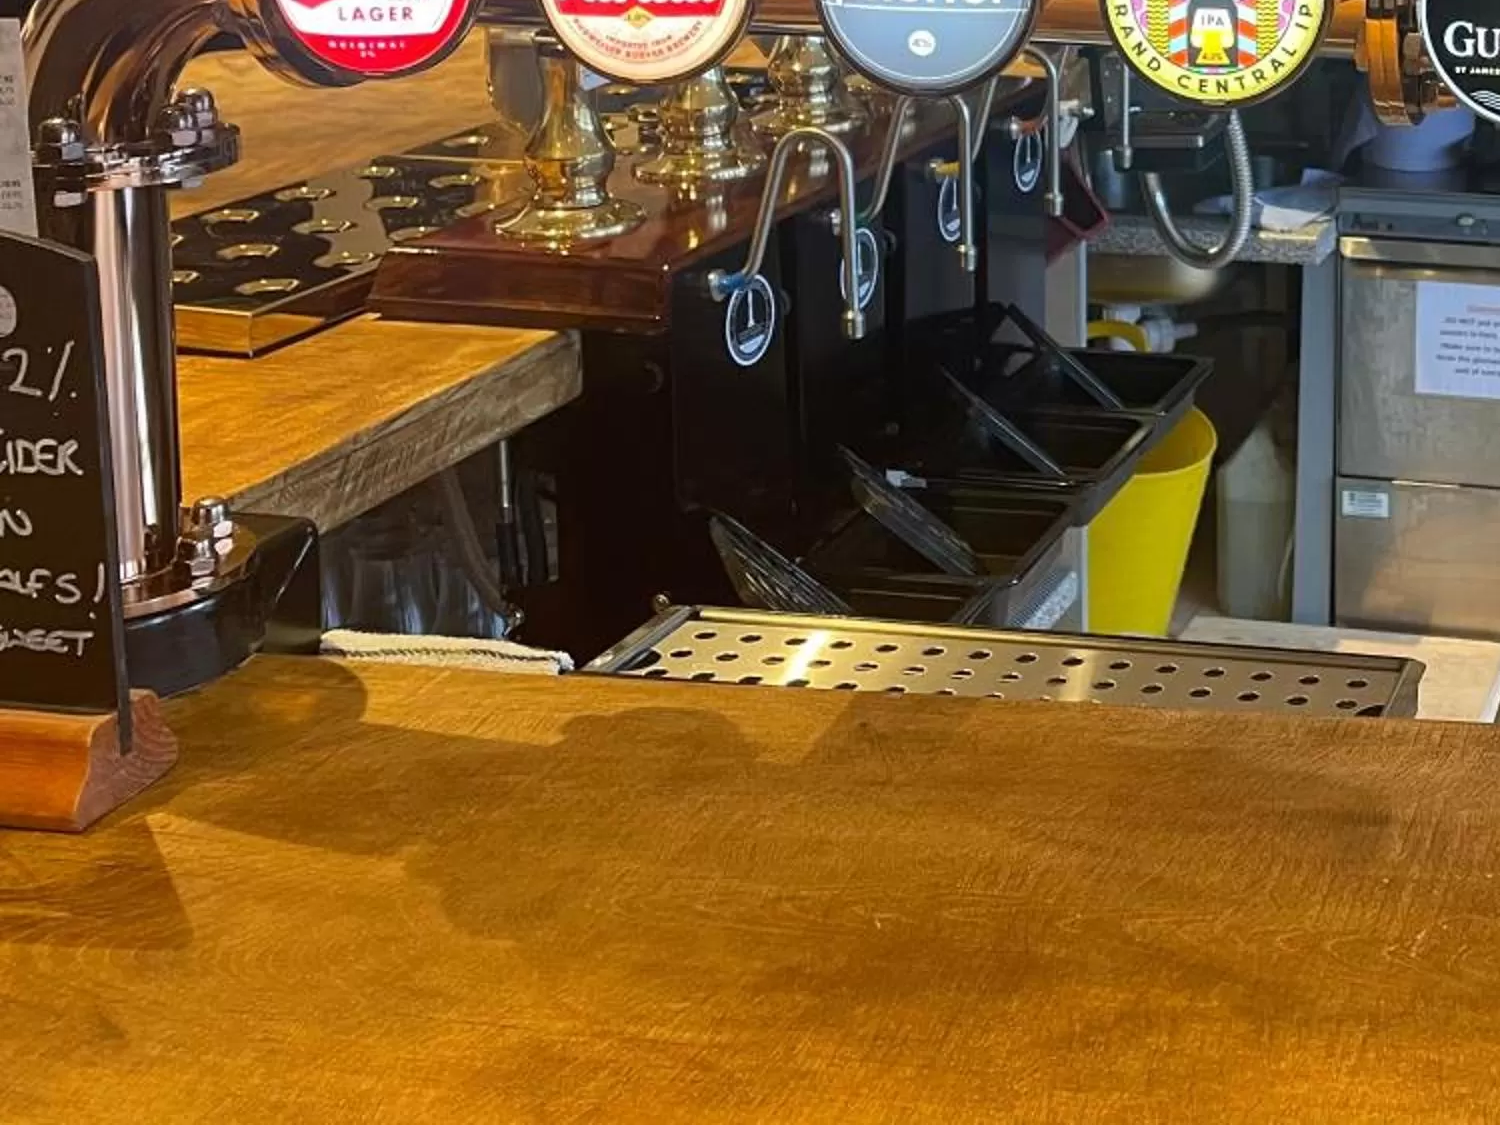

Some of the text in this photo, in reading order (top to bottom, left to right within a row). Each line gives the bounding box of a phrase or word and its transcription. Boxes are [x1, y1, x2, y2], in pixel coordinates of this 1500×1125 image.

[337, 6, 414, 21] LAGER
[1200, 14, 1225, 26] IPA
[1177, 45, 1297, 94] CENTRAL
[0, 428, 84, 475] IDER
